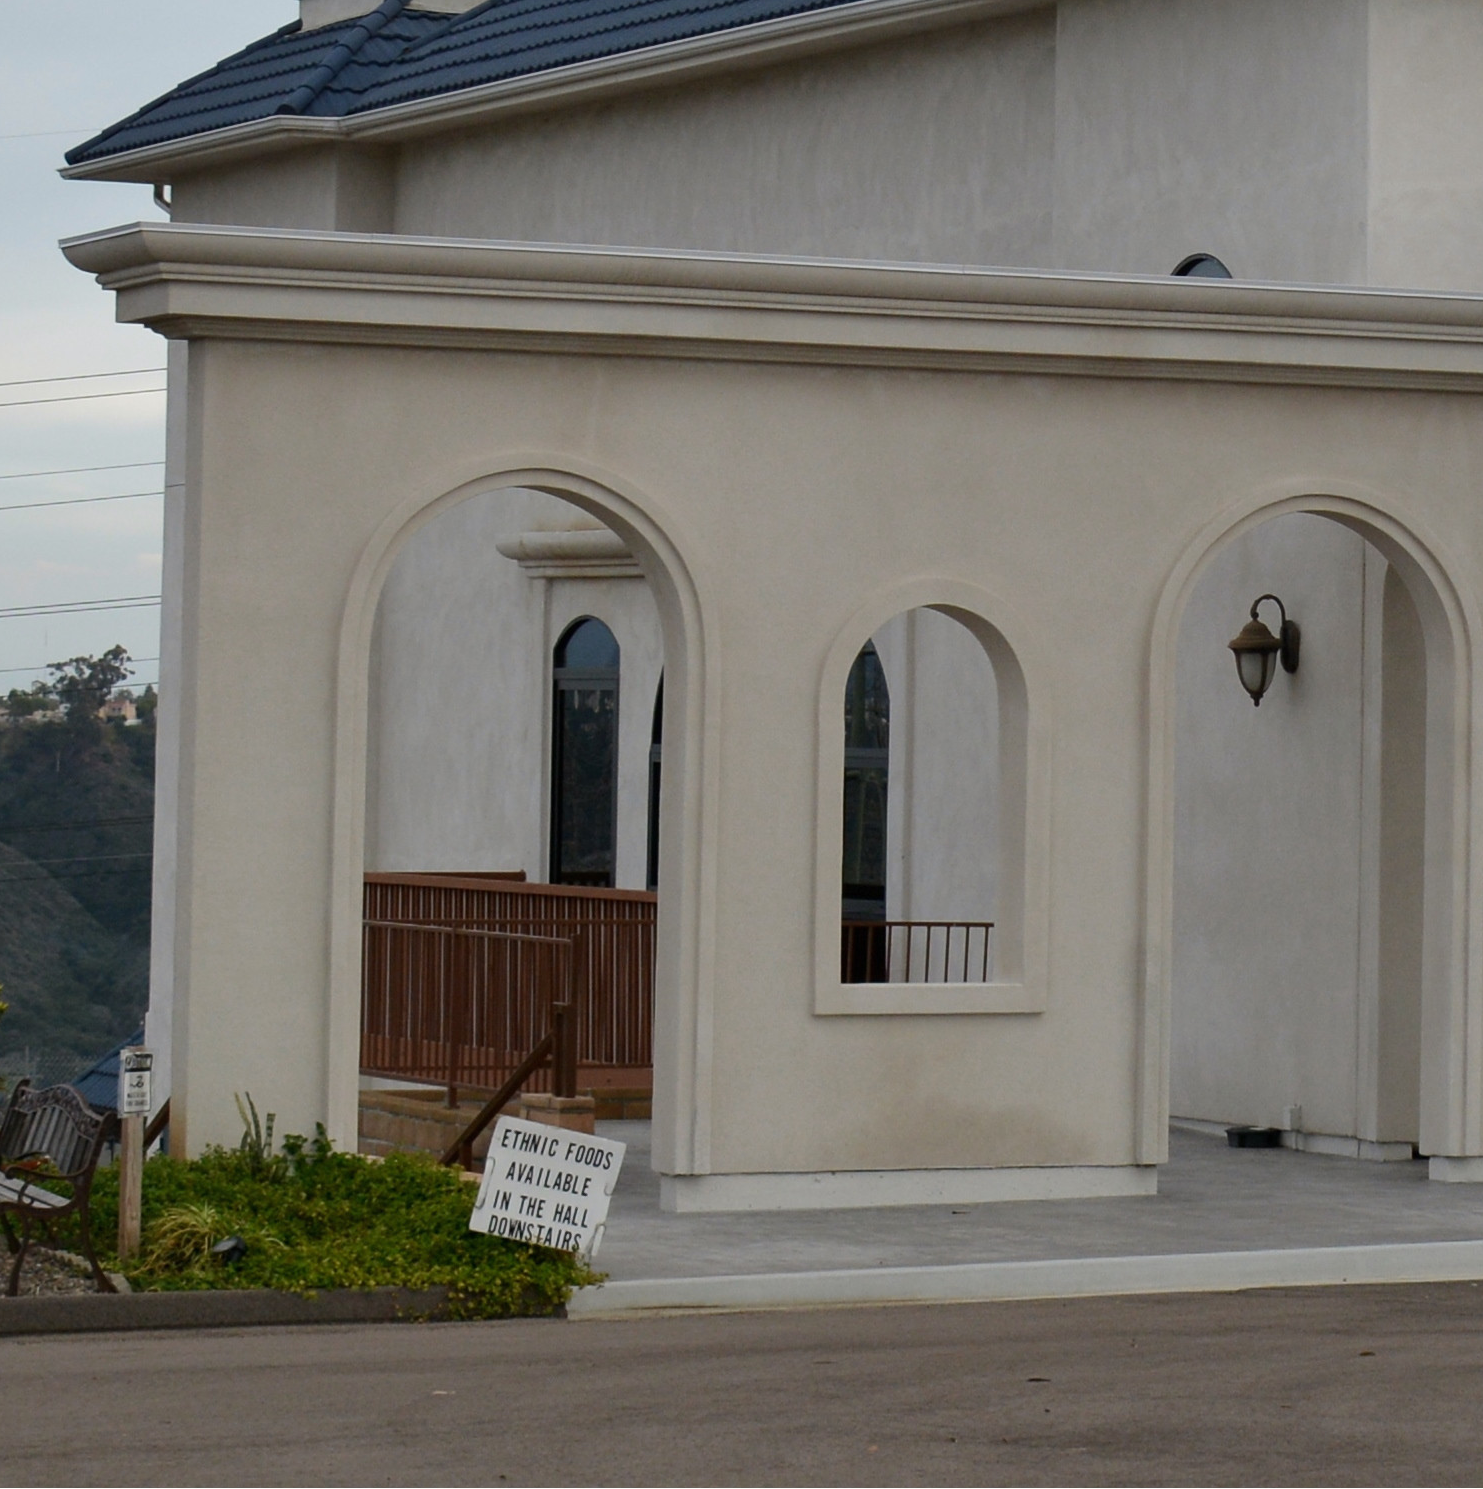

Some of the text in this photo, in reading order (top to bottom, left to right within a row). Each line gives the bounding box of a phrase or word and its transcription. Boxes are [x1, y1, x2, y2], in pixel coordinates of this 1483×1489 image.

[501, 1128, 614, 1170] ETHNIC FOODS
[505, 1162, 592, 1197] AVAILABLE
[493, 1189, 589, 1229] IN THE HALL
[488, 1214, 582, 1252] DOWNSTAIRS
